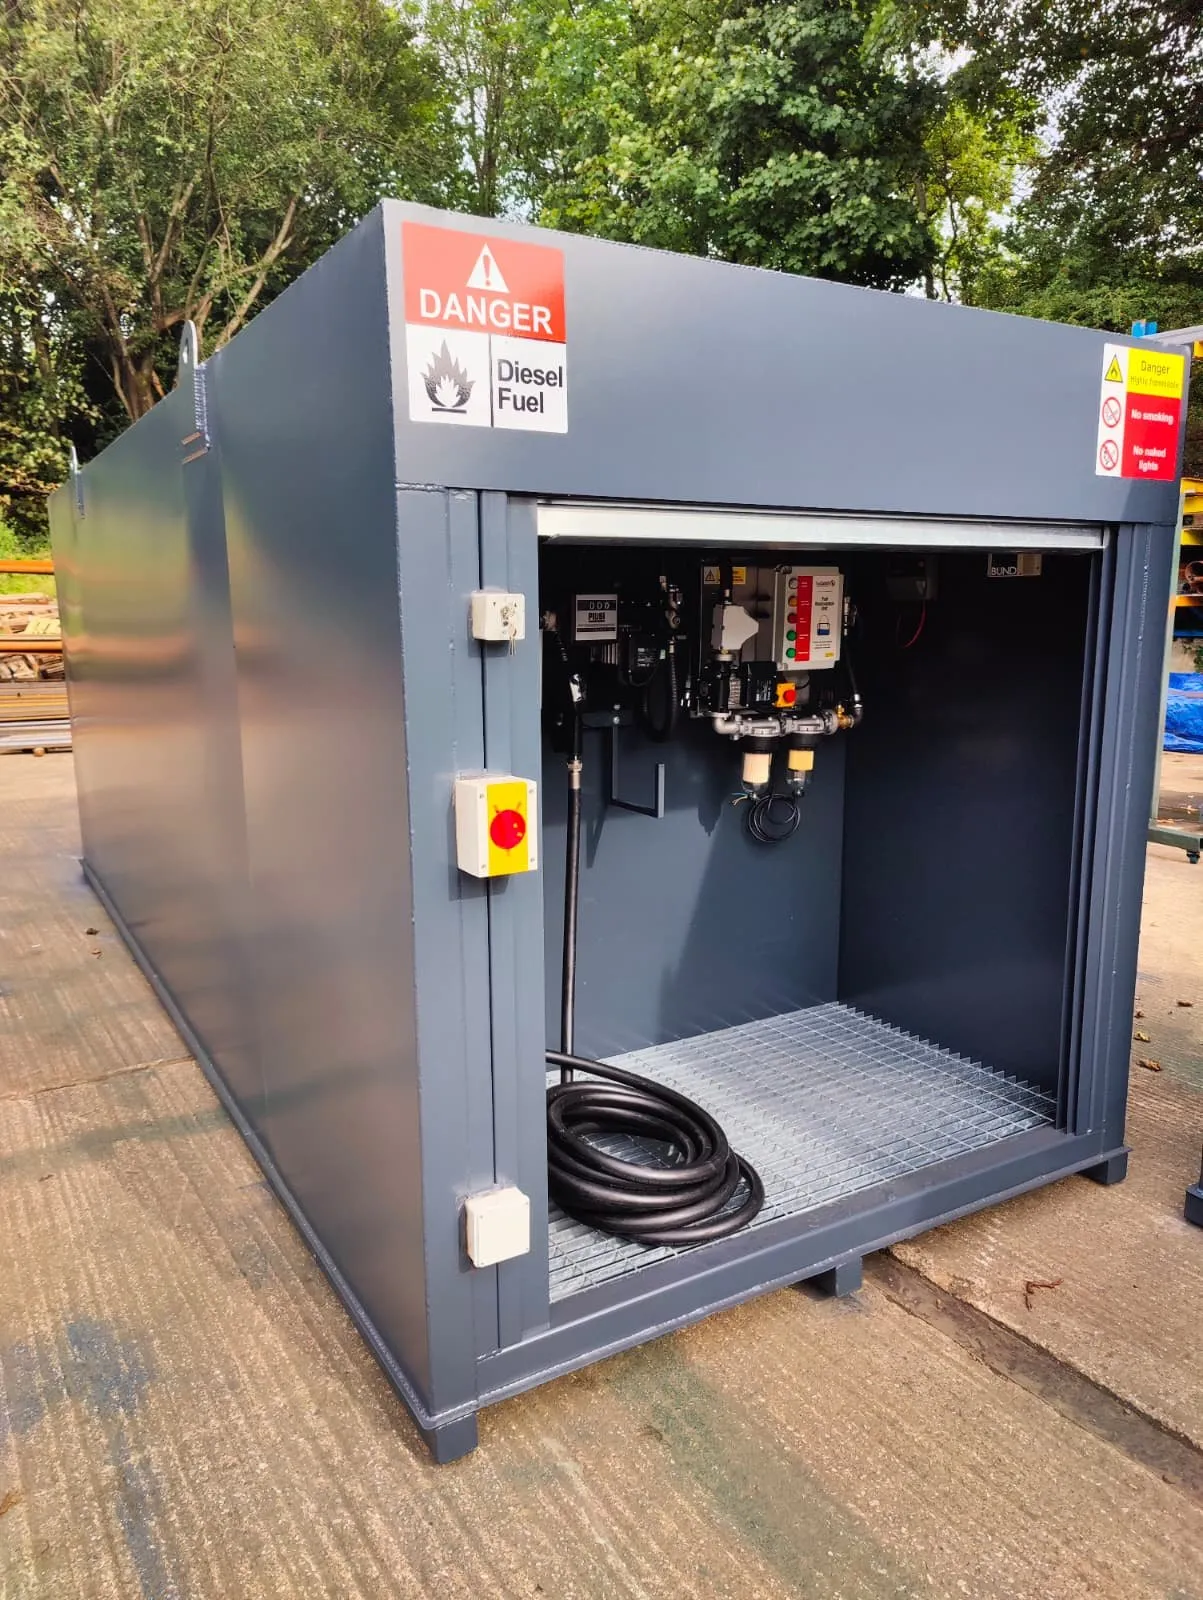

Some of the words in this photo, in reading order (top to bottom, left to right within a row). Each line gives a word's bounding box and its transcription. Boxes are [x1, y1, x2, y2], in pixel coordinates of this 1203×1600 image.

[419, 288, 553, 335] DANGER
[497, 358, 563, 388] Diesel
[1140, 359, 1171, 377] Danger
[498, 387, 544, 414] Fuel
[1131, 408, 1142, 420] No
[1142, 411, 1174, 426] smoking
[1133, 444, 1144, 456] No
[1144, 447, 1167, 458] naked
[1138, 459, 1159, 473] lights
